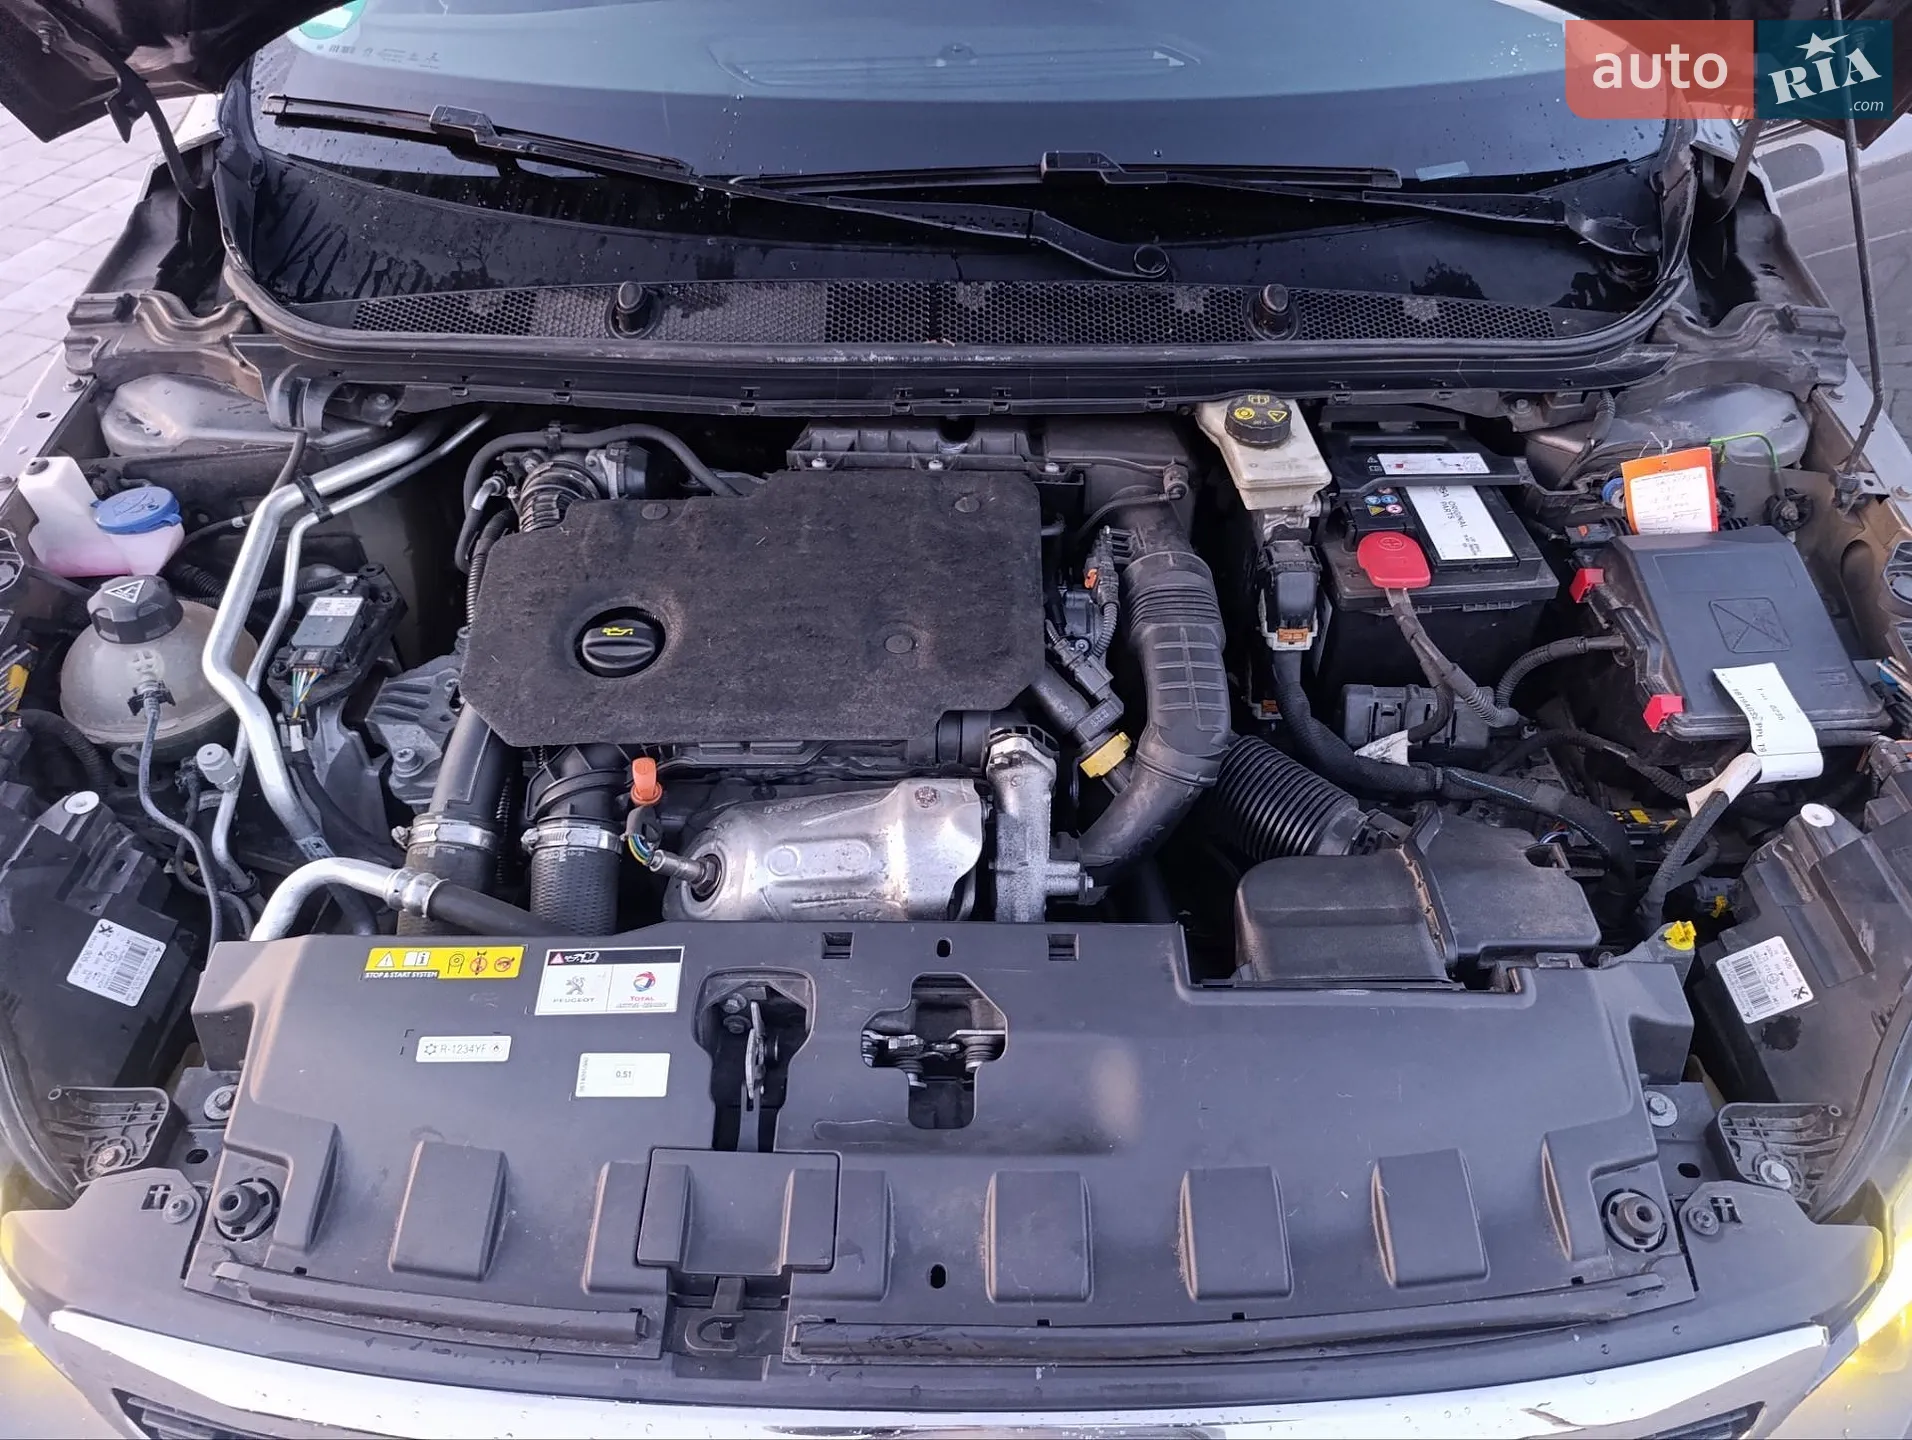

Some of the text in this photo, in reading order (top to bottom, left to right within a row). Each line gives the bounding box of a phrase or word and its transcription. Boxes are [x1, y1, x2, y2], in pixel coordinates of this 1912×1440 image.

[1447, 500, 1468, 528] ORIGINAL
[365, 971, 384, 979] STOP
[389, 971, 412, 979] START
[411, 971, 438, 979] SYSTEM
[440, 1043, 487, 1055] R-1234YF
[615, 1070, 632, 1079] 0.51
